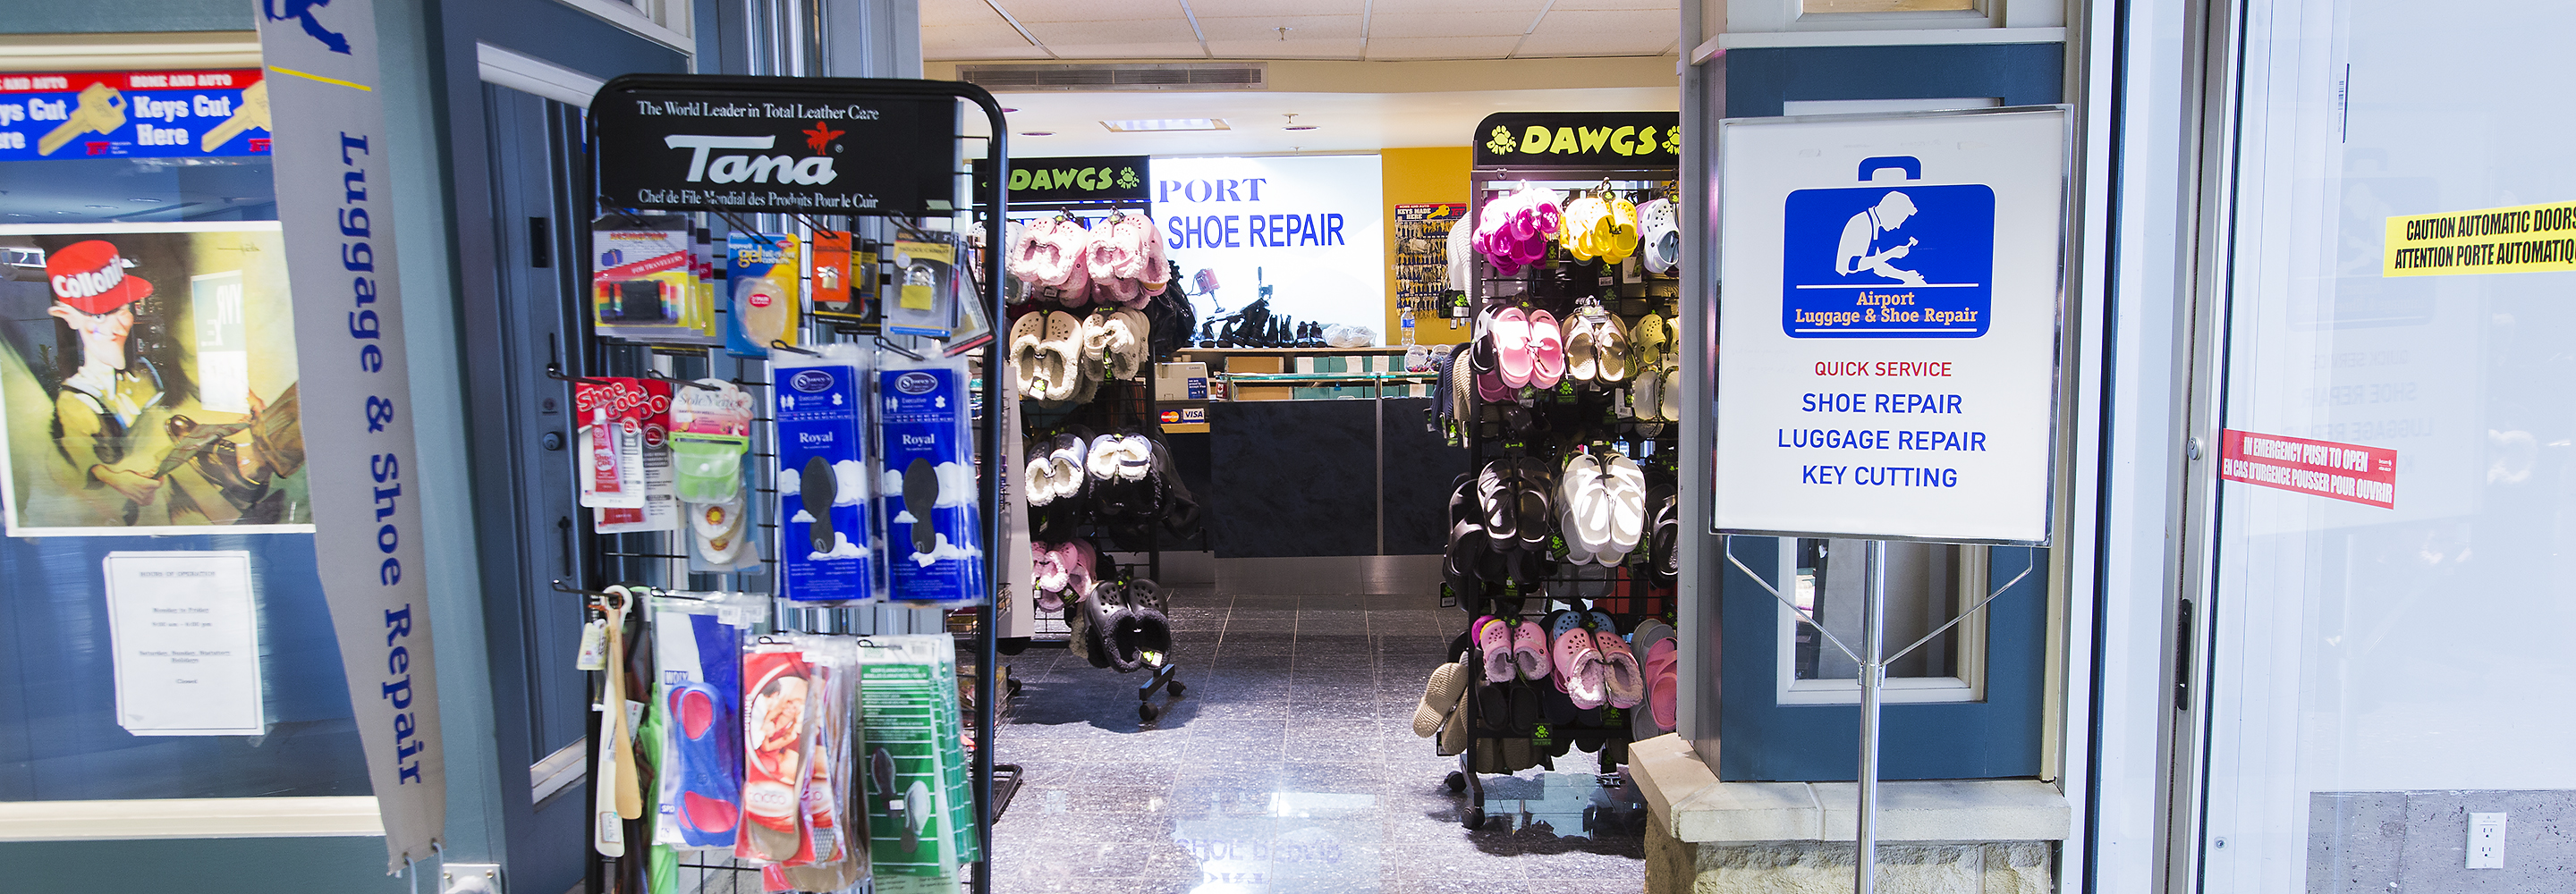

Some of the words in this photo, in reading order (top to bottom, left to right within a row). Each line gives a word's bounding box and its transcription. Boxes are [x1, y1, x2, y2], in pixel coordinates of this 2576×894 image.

[4, 77, 31, 90] AND
[32, 76, 69, 89] AUTO
[130, 75, 168, 88] HOME
[169, 75, 196, 87] AND
[198, 74, 233, 87] AUTO
[0, 103, 25, 127] ys
[28, 97, 69, 122] Cut
[133, 96, 190, 122] Keys
[193, 95, 233, 118] Cut
[636, 100, 663, 115] The
[665, 101, 700, 116] World
[702, 102, 747, 117] Leader
[748, 103, 760, 117] in
[762, 103, 795, 118] Total
[797, 104, 846, 120] Leather
[847, 105, 880, 120] Care
[0, 131, 26, 150] re
[136, 123, 190, 147] Here
[1486, 136, 1517, 156] DAWGS
[1519, 125, 1657, 156] DAWGS
[664, 133, 839, 186] Tana
[1008, 166, 1114, 191] DAWGS
[1146, 178, 1267, 203] PORT
[638, 189, 666, 204] Chef
[666, 190, 680, 204] de
[681, 190, 702, 205] File
[748, 190, 766, 206] des
[814, 191, 841, 207] Pour
[841, 192, 852, 208] le
[852, 192, 879, 208] Cuir
[1168, 215, 1240, 249] SHOE
[1250, 214, 1345, 247] REPAIR
[2406, 216, 2456, 241] CAUTION
[2457, 210, 2530, 238] AUTOMATIC
[337, 131, 385, 374] Luggage
[738, 244, 763, 268] gel
[2394, 246, 2454, 270] ATTENTION
[2456, 243, 2496, 267] PORTE
[2496, 238, 2576, 266] AUTOMATIQ
[53, 253, 124, 298] Collonil
[1857, 291, 1915, 310] Airport
[1795, 308, 1860, 327] Luggage
[1864, 308, 1877, 323] &
[1880, 308, 1919, 323] Shoe
[1924, 307, 1979, 325] Repair
[1814, 361, 1870, 377] QUICK
[1875, 361, 1952, 377] SERVICE
[576, 382, 626, 412] Shoe
[603, 391, 640, 420] Goo
[1801, 392, 1867, 413] SHOE
[1875, 393, 1962, 414] REPAIR
[365, 395, 395, 434] &
[1184, 410, 1204, 418] VISA
[799, 431, 834, 445] Royal
[902, 433, 936, 446] Royal
[1778, 428, 1889, 450] LUGGAGE
[1898, 431, 1987, 451] REPAIR
[2243, 436, 2253, 456] IN
[2253, 437, 2302, 463] EMERGENCY
[2303, 443, 2328, 467] PUSH
[2329, 447, 2342, 469] TO
[2343, 449, 2368, 473] OPEN
[1802, 465, 1847, 485] KEY
[1855, 466, 1958, 488] CUTTING
[2223, 458, 2233, 476] EN
[2233, 460, 2249, 479] CAS
[2249, 461, 2292, 486] D'URGENCE
[2292, 468, 2329, 493] POUSSER
[2331, 475, 2356, 497] POUR
[2356, 478, 2394, 504] OUVRIR
[369, 451, 402, 587] Shoe
[381, 602, 422, 787] Repair
